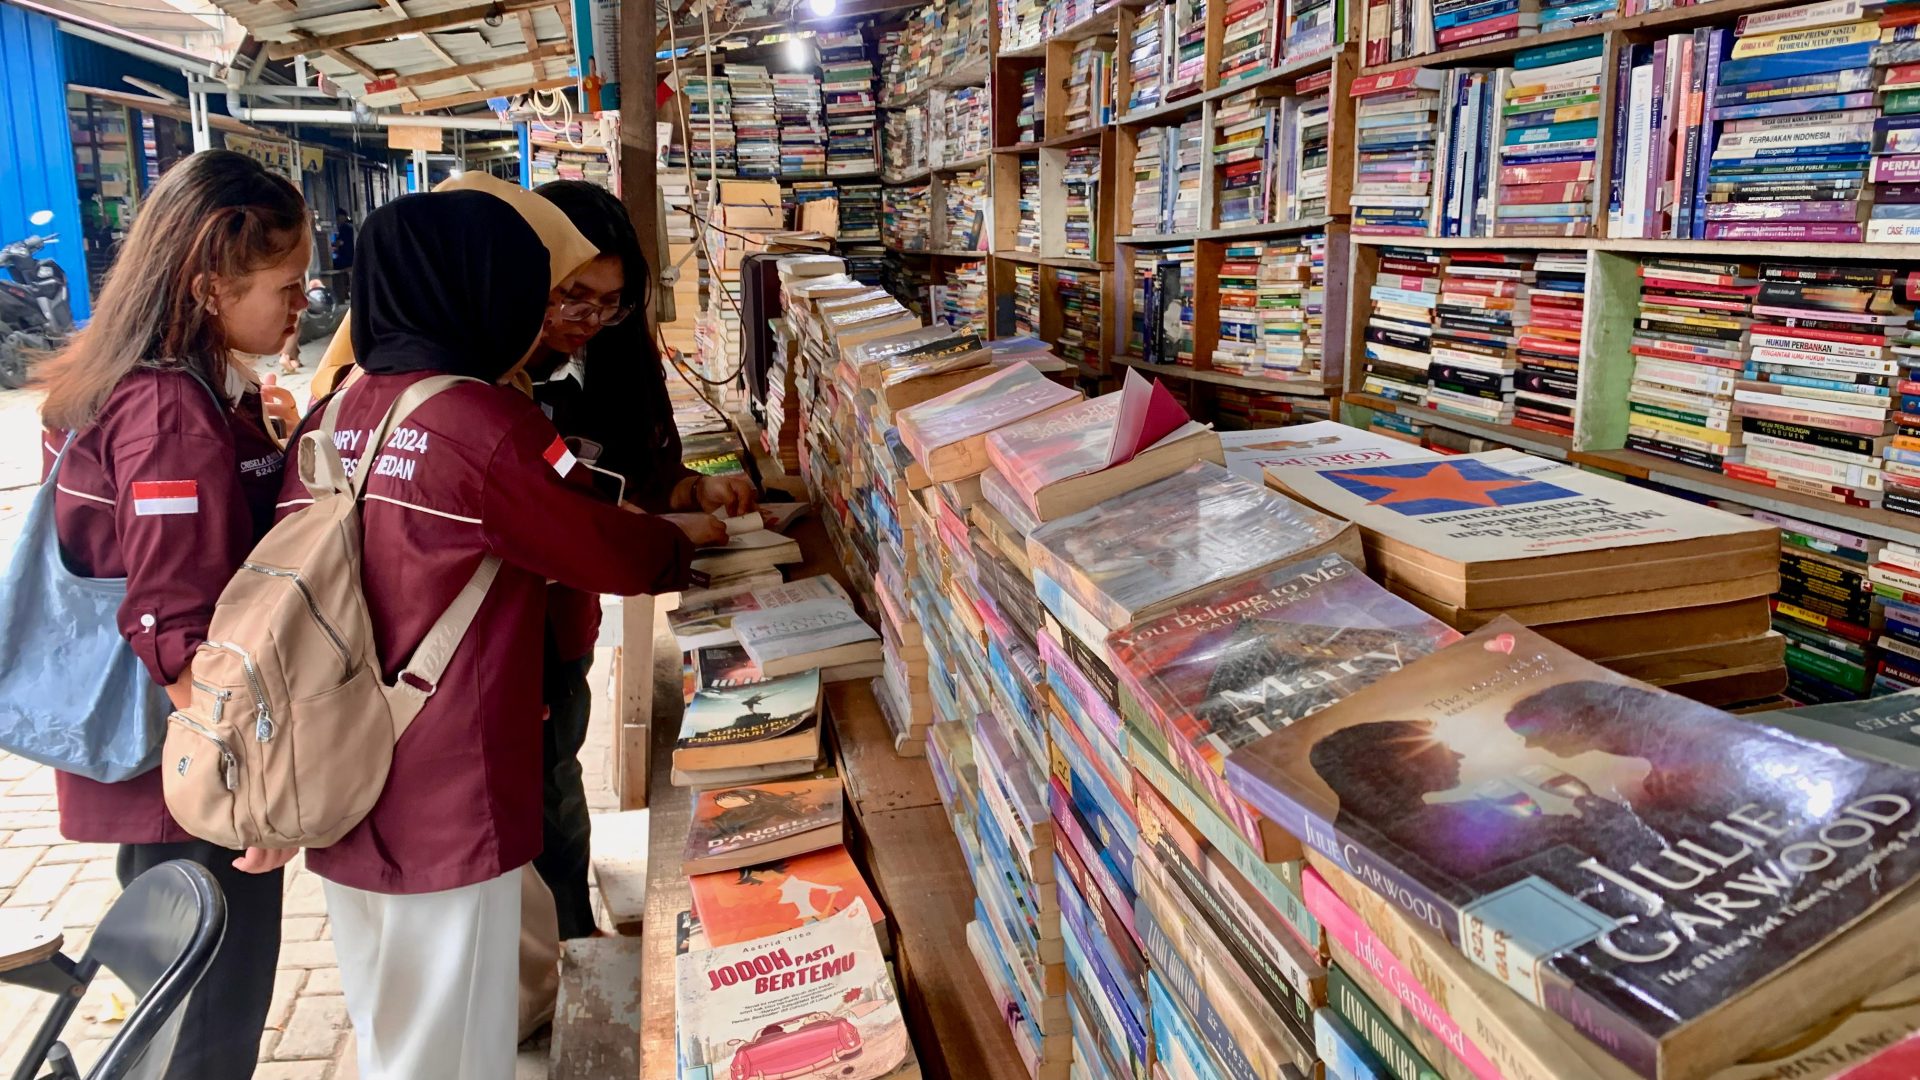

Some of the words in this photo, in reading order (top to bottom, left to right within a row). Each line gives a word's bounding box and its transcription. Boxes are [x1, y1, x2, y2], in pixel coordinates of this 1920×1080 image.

[1748, 133, 1792, 144] PERPAJAKAN
[1792, 131, 1831, 141] INDONESIA
[1760, 349, 1791, 358] PENGANTAR
[1791, 352, 1804, 360] ILMU
[1805, 354, 1826, 362] HUKUM
[1765, 338, 1791, 348] HUKUM
[1791, 340, 1833, 353] PERBANKAN
[387, 427, 428, 454] 2024
[1254, 451, 1392, 468] KORUPSI
[1418, 498, 1616, 524] Pembangunan
[1448, 524, 1504, 539] dan
[1118, 624, 1169, 648] You
[1173, 592, 1264, 630] Belong
[1269, 582, 1299, 599] to
[1299, 565, 1347, 588] Me
[1197, 613, 1233, 633] KAU
[1240, 590, 1312, 620] MILIKKU
[1219, 642, 1404, 714] Mary
[688, 729, 765, 744] PEMBUNUH
[707, 718, 789, 737] KUPU-KUPU
[1303, 815, 1341, 862] JULIE
[1343, 843, 1442, 930] GARWOOD
[1577, 802, 1790, 917] JULIE
[1595, 793, 1911, 963] GARWOOD
[743, 939, 782, 953] Astrid
[1660, 967, 1696, 986] The
[1708, 936, 1750, 960] New
[1743, 915, 1783, 939] York
[1781, 889, 1830, 918] Times
[707, 947, 793, 992] JODOH
[794, 943, 836, 967] PASTI
[754, 951, 856, 995] BERTEMU
[1341, 985, 1370, 1042] LINDA
[1354, 930, 1384, 977] Julie
[1388, 964, 1466, 1057] Garwood
